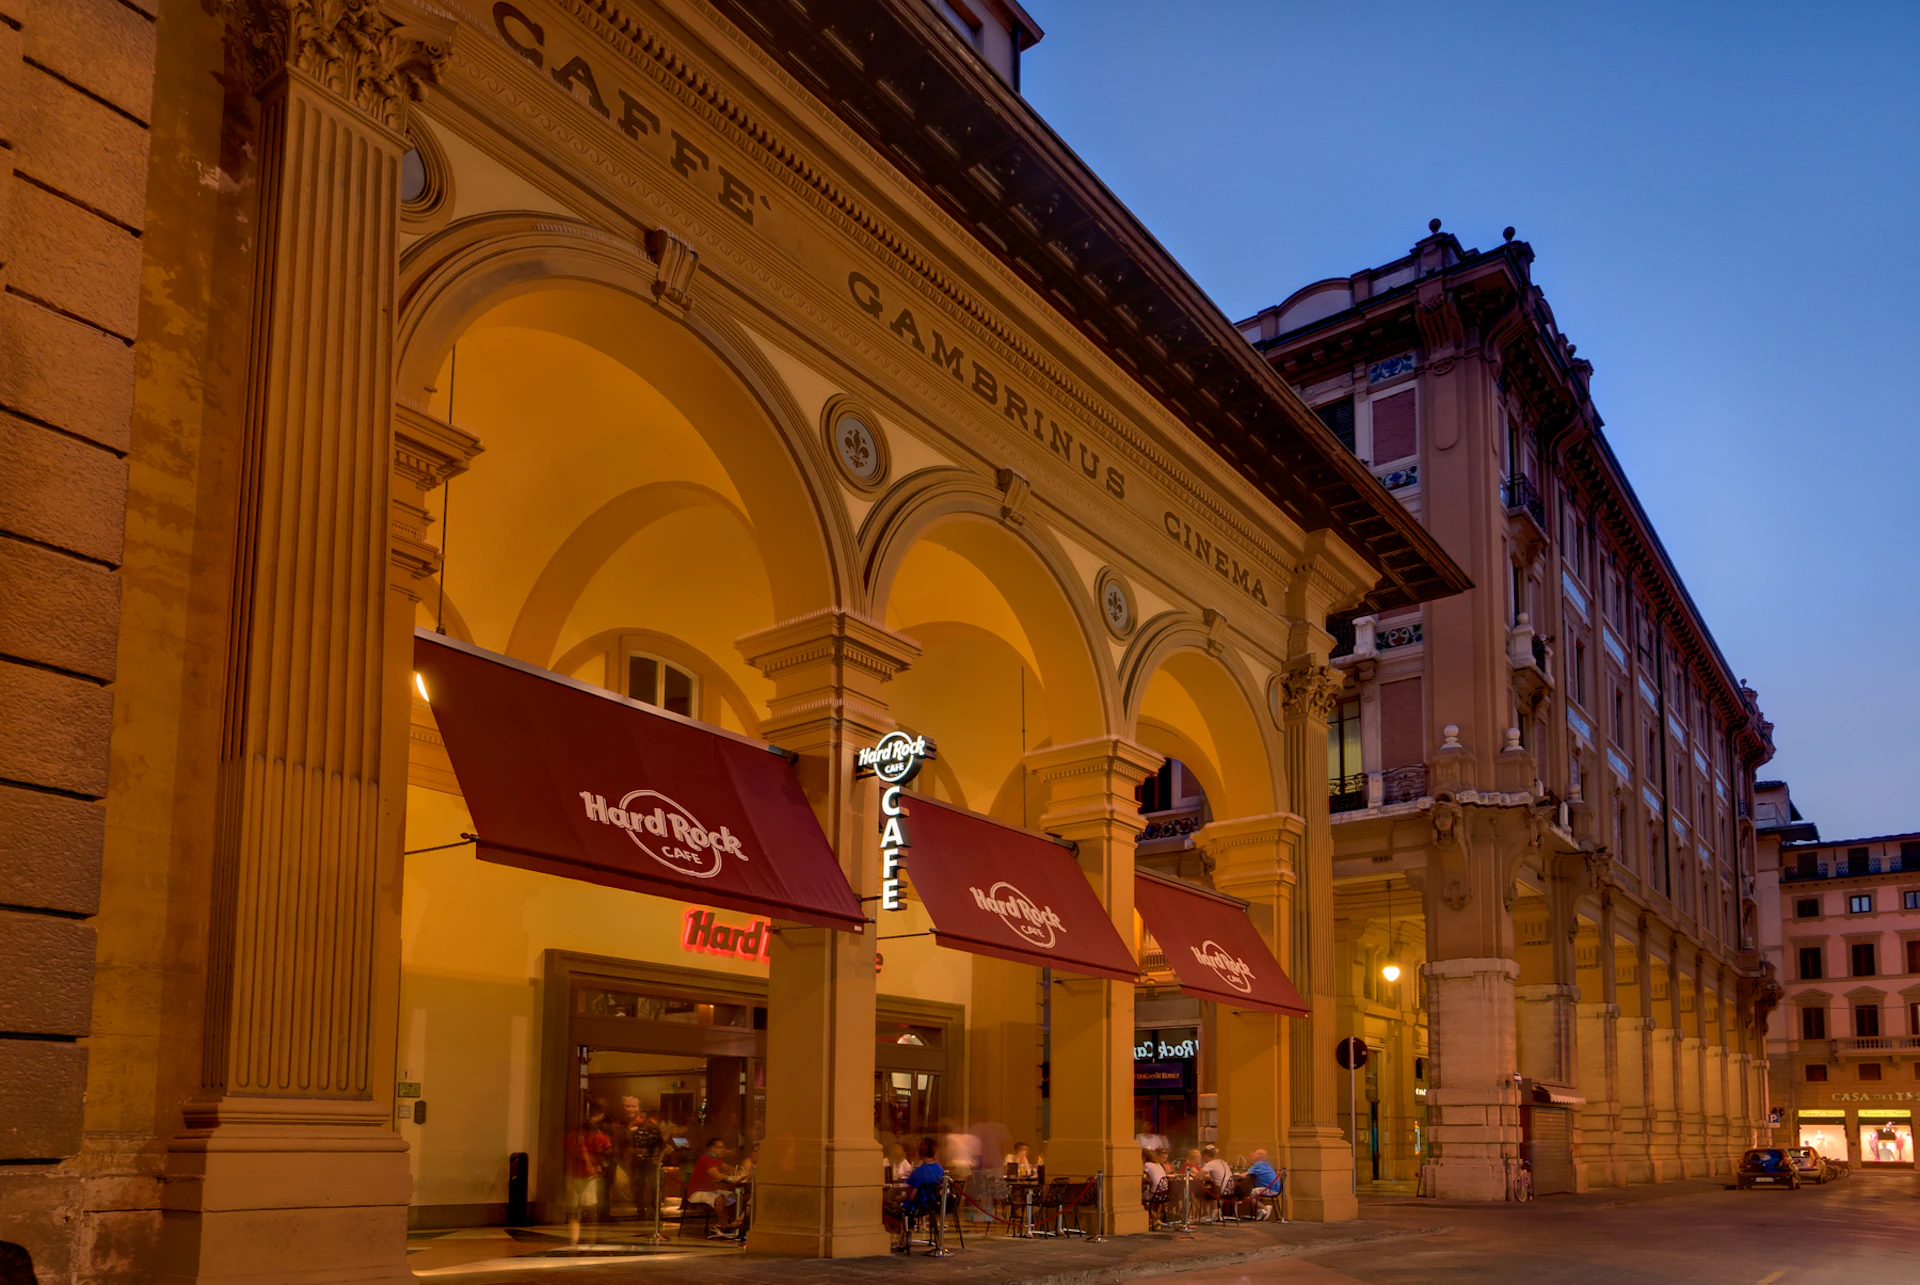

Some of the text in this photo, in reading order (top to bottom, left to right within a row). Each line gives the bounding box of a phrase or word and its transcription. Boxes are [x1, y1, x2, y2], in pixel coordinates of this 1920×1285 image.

[847, 271, 1125, 500] GAMBRINUS
[1163, 511, 1268, 607] CINEMA
[858, 735, 926, 767] Hard Rock
[884, 761, 905, 775] CAFE
[579, 790, 749, 861] Hard Rock
[661, 845, 703, 865] CAFE
[880, 785, 906, 911] CAFE
[969, 886, 1068, 933] Hard Rock
[683, 910, 765, 956] Hard
[1190, 945, 1227, 970] Hard
[1831, 1092, 1870, 1102] CASA
[1770, 1114, 1777, 1122] P
